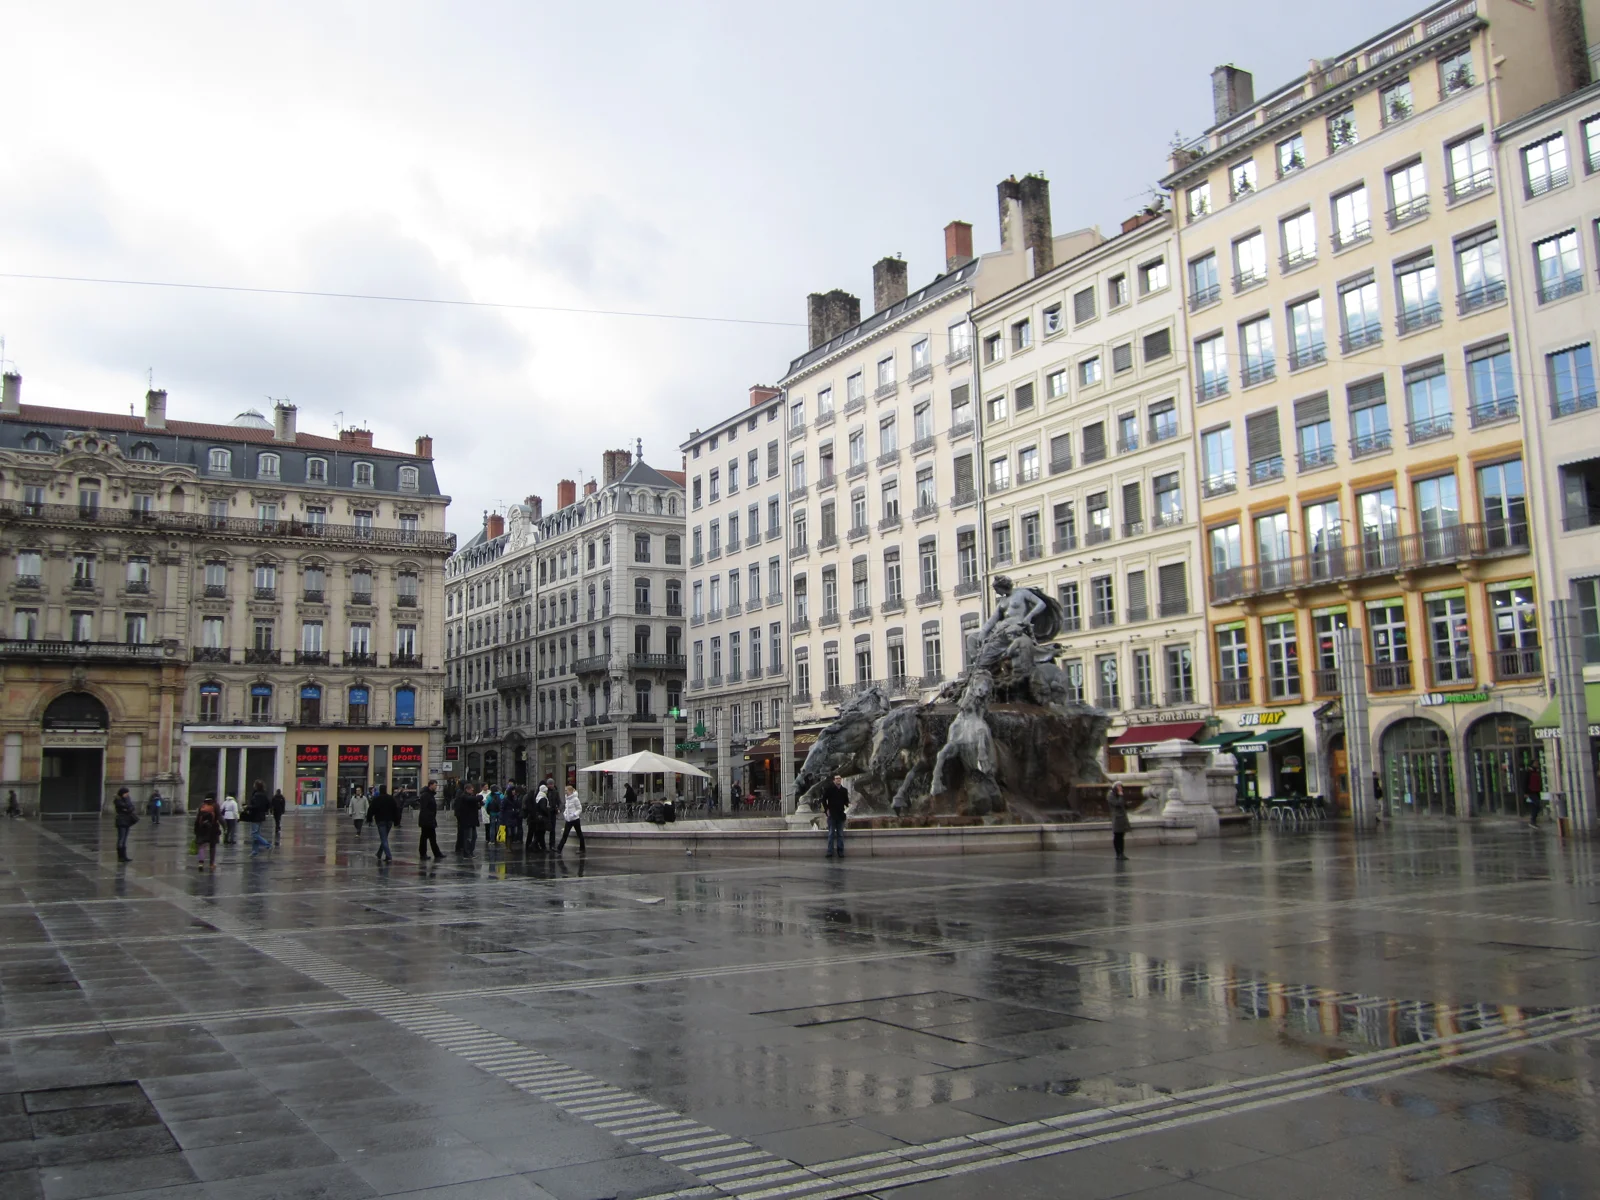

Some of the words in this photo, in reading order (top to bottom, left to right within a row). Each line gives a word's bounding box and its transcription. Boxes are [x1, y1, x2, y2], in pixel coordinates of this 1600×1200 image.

[1444, 693, 1487, 704] PREMIUM
[1136, 714, 1148, 723] La
[1153, 710, 1199, 721] Fontaine
[1238, 710, 1285, 726] SUBWAY
[1237, 744, 1264, 753] SALADES
